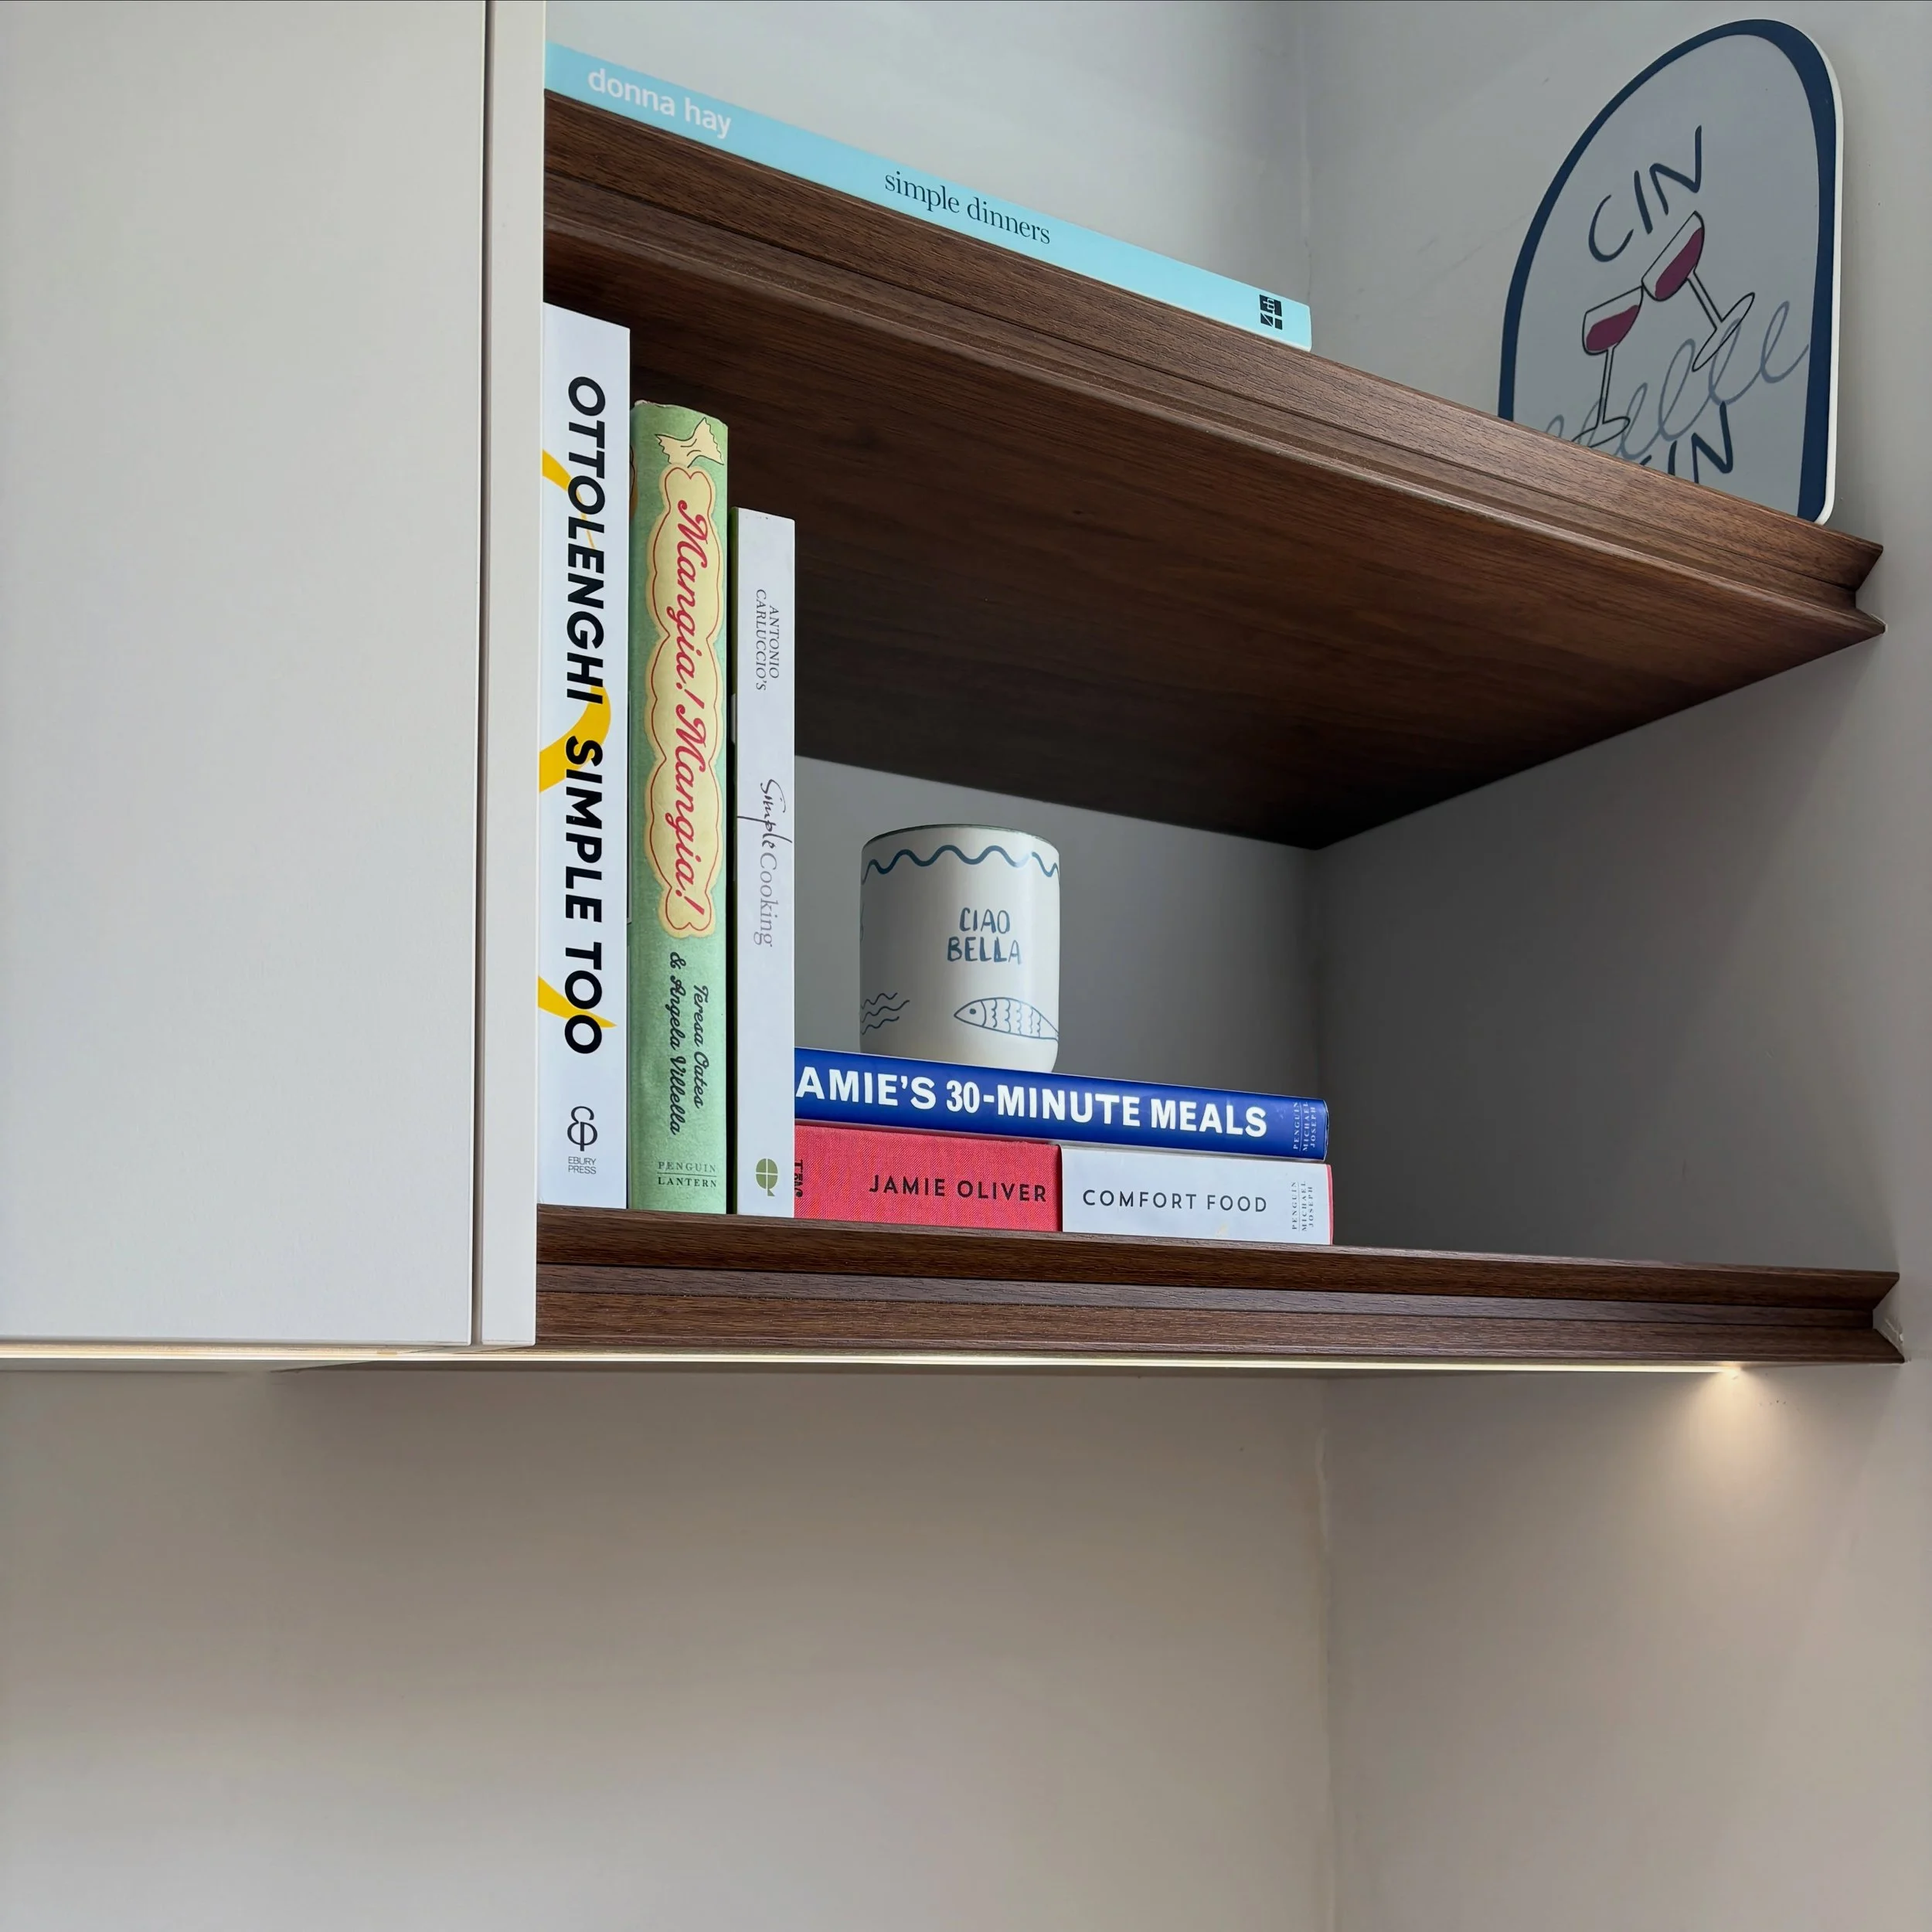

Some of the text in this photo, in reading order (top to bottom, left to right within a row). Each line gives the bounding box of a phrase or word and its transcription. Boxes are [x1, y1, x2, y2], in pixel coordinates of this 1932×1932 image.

[588, 67, 732, 139] donna hay
[884, 171, 1050, 245] simple dinners
[1588, 124, 1702, 262] CIN
[1640, 400, 1733, 484] IN
[756, 588, 767, 691] CARLUCCIO'S
[768, 605, 780, 679] ANTONIO
[565, 376, 606, 1054] OTTOLENGHI SIMPLE TOO
[665, 499, 708, 915] Mangia! Mangia!
[736, 779, 792, 947] Simple Cooking
[946, 937, 1022, 965] BELLA
[958, 906, 1010, 934] CIAO
[665, 951, 686, 1135] & Angela Villella
[694, 985, 709, 1109] Teresa Oates
[795, 1066, 1267, 1138] AMIE'S 30-MINUTE MEALS
[568, 1156, 597, 1165] EBURY
[568, 1165, 597, 1175] PRESS
[658, 1161, 716, 1173] PENGUIN
[658, 1176, 717, 1188] LANTERN
[869, 1174, 1047, 1202] JAMIE OLIVER
[1083, 1189, 1267, 1213] COMFORT FOOD
